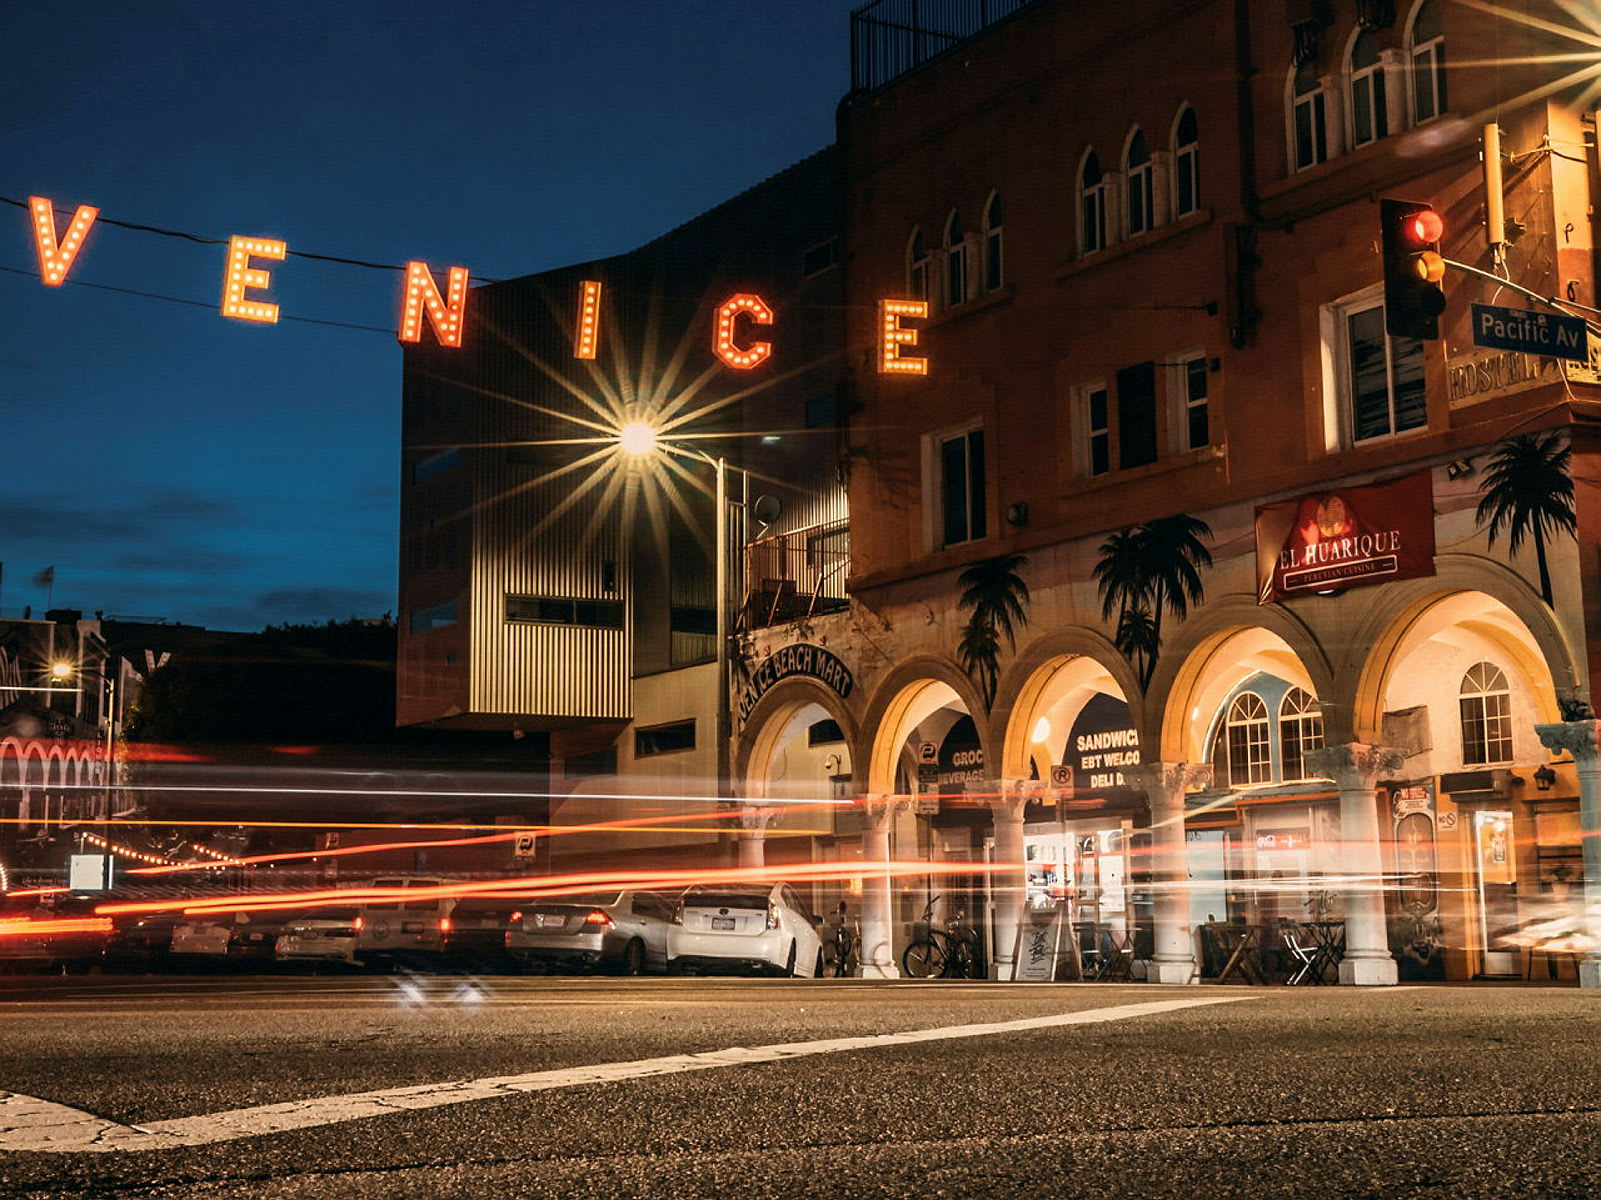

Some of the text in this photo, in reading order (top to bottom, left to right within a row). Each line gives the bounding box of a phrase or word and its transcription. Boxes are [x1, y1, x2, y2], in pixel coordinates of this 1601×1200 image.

[29, 196, 928, 374] VENICE
[1481, 313, 1579, 349] Pacific Av
[1280, 530, 1401, 570] EL HUARIQUE
[740, 647, 850, 719] VENICE BEACH MART
[1081, 750, 1141, 770] EBT WELCO
[1090, 773, 1114, 788] DELI
